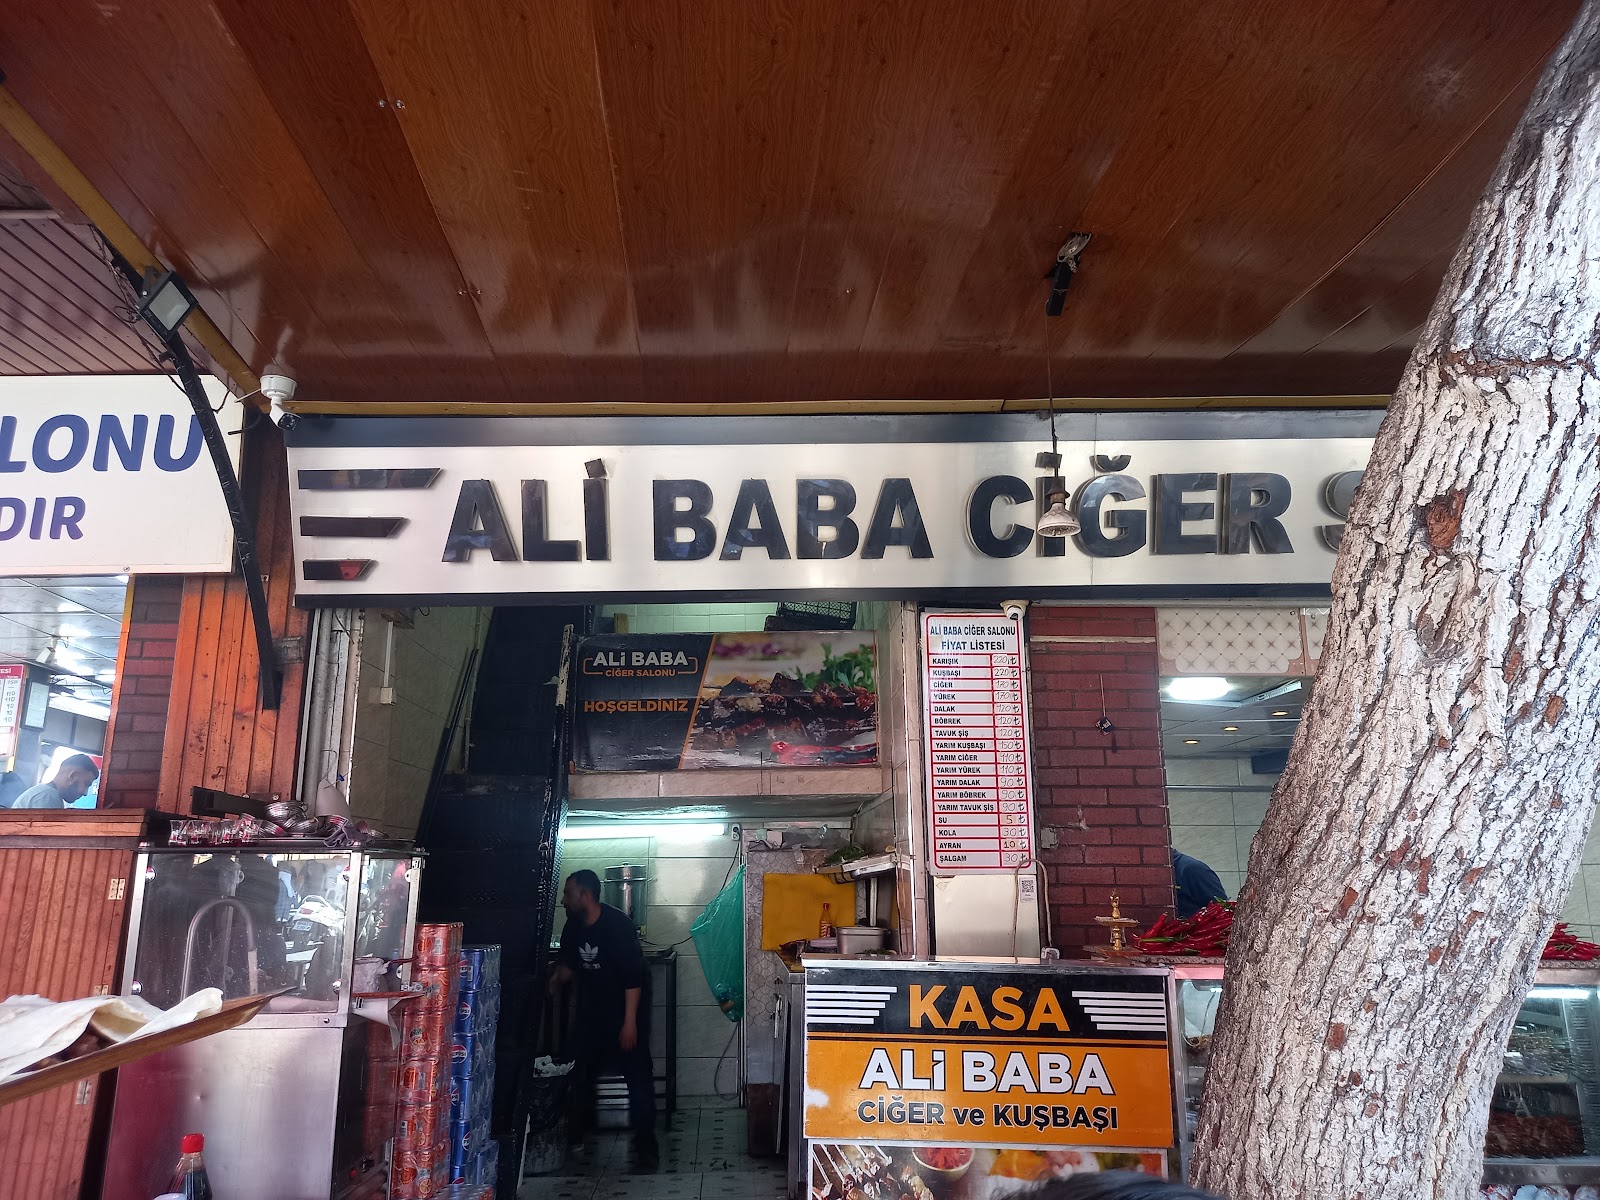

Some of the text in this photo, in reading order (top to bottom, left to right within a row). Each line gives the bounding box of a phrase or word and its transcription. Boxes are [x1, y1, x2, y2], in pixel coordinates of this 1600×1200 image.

[441, 458, 611, 562] ALİ
[652, 477, 935, 561] BABA
[965, 451, 1296, 558] CİĞER
[943, 626, 962, 636] BABA
[964, 624, 986, 636] CİĞER
[987, 626, 1016, 636] SALONU
[941, 639, 1006, 650] FİYAT LİSTESİ
[631, 651, 689, 666] BABA
[932, 658, 959, 666] KARIŞIK
[605, 668, 676, 677] CİĞER SALONU
[932, 669, 961, 678] KUŞBAŞI
[933, 680, 953, 688] CİĞER
[584, 698, 689, 714] HOŞGELDİNİZ
[958, 728, 969, 738] ŞİŞ
[957, 742, 986, 750] KUŞBAŞI
[957, 752, 978, 761] CİĞER
[960, 790, 987, 799] BÖBREK
[983, 803, 994, 812] ŞİŞ
[1006, 814, 1013, 824] 5
[1003, 828, 1017, 837] 30
[1003, 841, 1016, 849] 10
[1004, 853, 1018, 863] 30
[908, 984, 1071, 1032] KASA
[961, 1050, 1117, 1096] BABA
[857, 1095, 1119, 1133] CİĞER ve KUŞBAŞI
